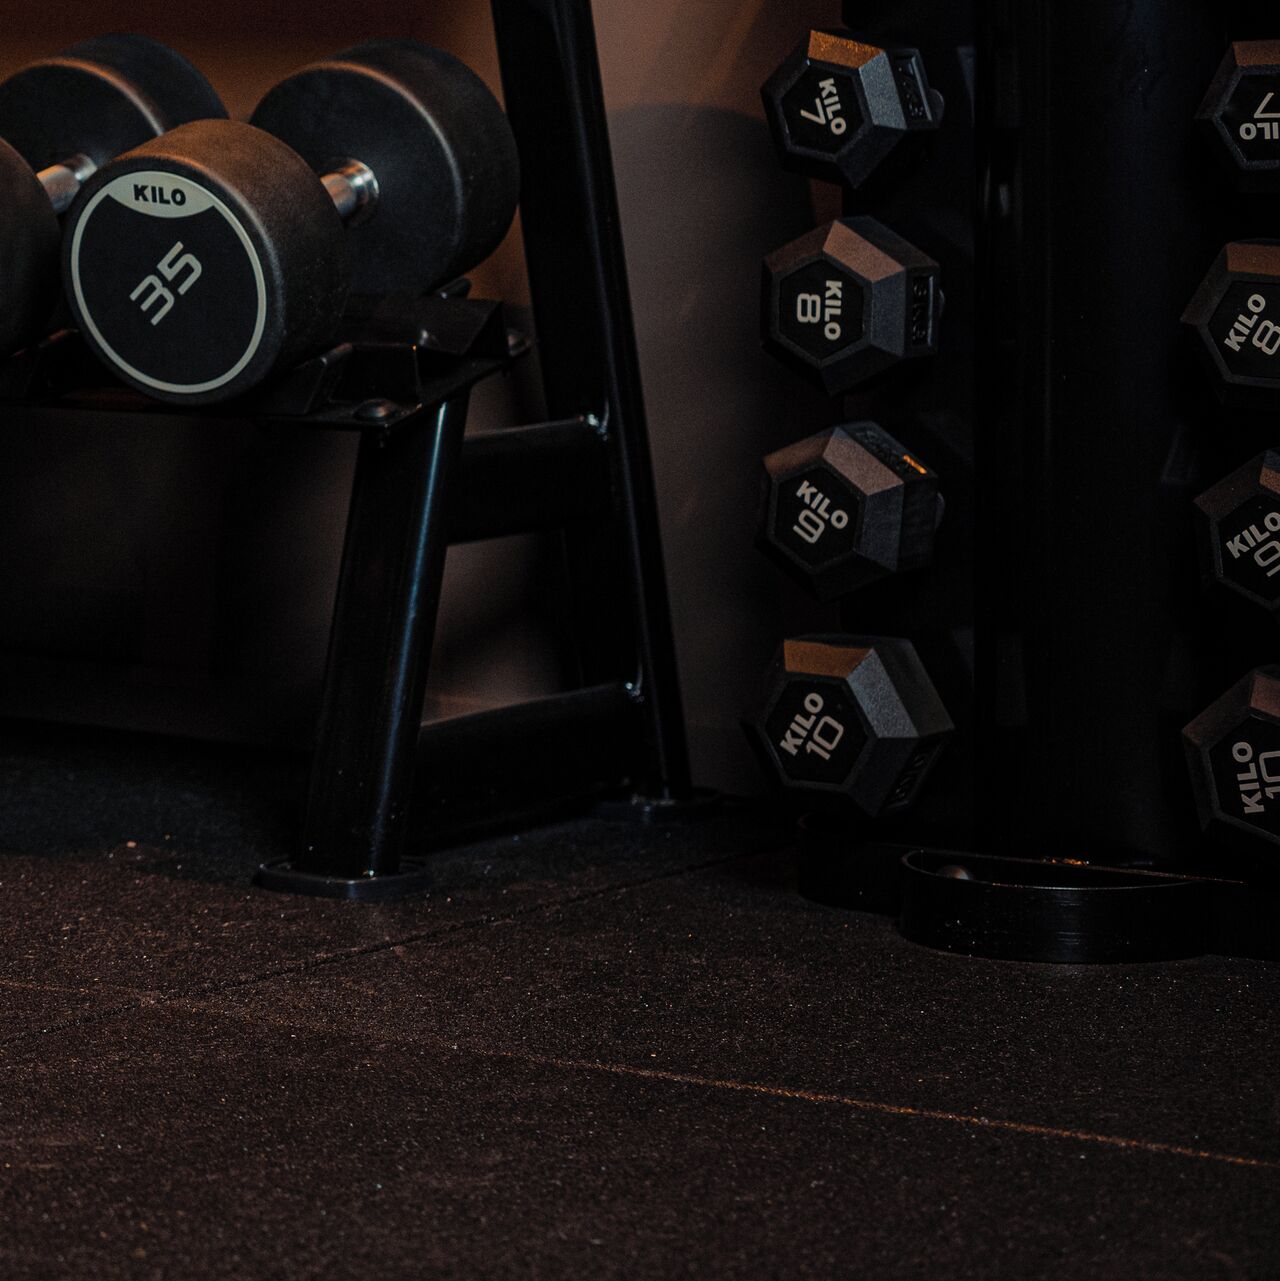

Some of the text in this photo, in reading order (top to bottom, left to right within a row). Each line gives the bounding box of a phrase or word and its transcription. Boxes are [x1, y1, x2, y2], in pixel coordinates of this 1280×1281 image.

[800, 98, 827, 125] 7
[818, 77, 847, 136] KILO
[1239, 122, 1280, 141] ILO
[133, 184, 187, 207] KILO
[129, 241, 203, 326] 35
[796, 291, 822, 325] 8
[822, 280, 843, 340] KILO
[1224, 294, 1266, 352] KILO
[1252, 320, 1280, 356] 8
[792, 508, 825, 544] 9
[795, 480, 849, 530] KILO
[1226, 512, 1280, 560] KILO
[780, 691, 824, 759] KILO
[806, 714, 845, 760] 10
[1232, 741, 1265, 815] KILO
